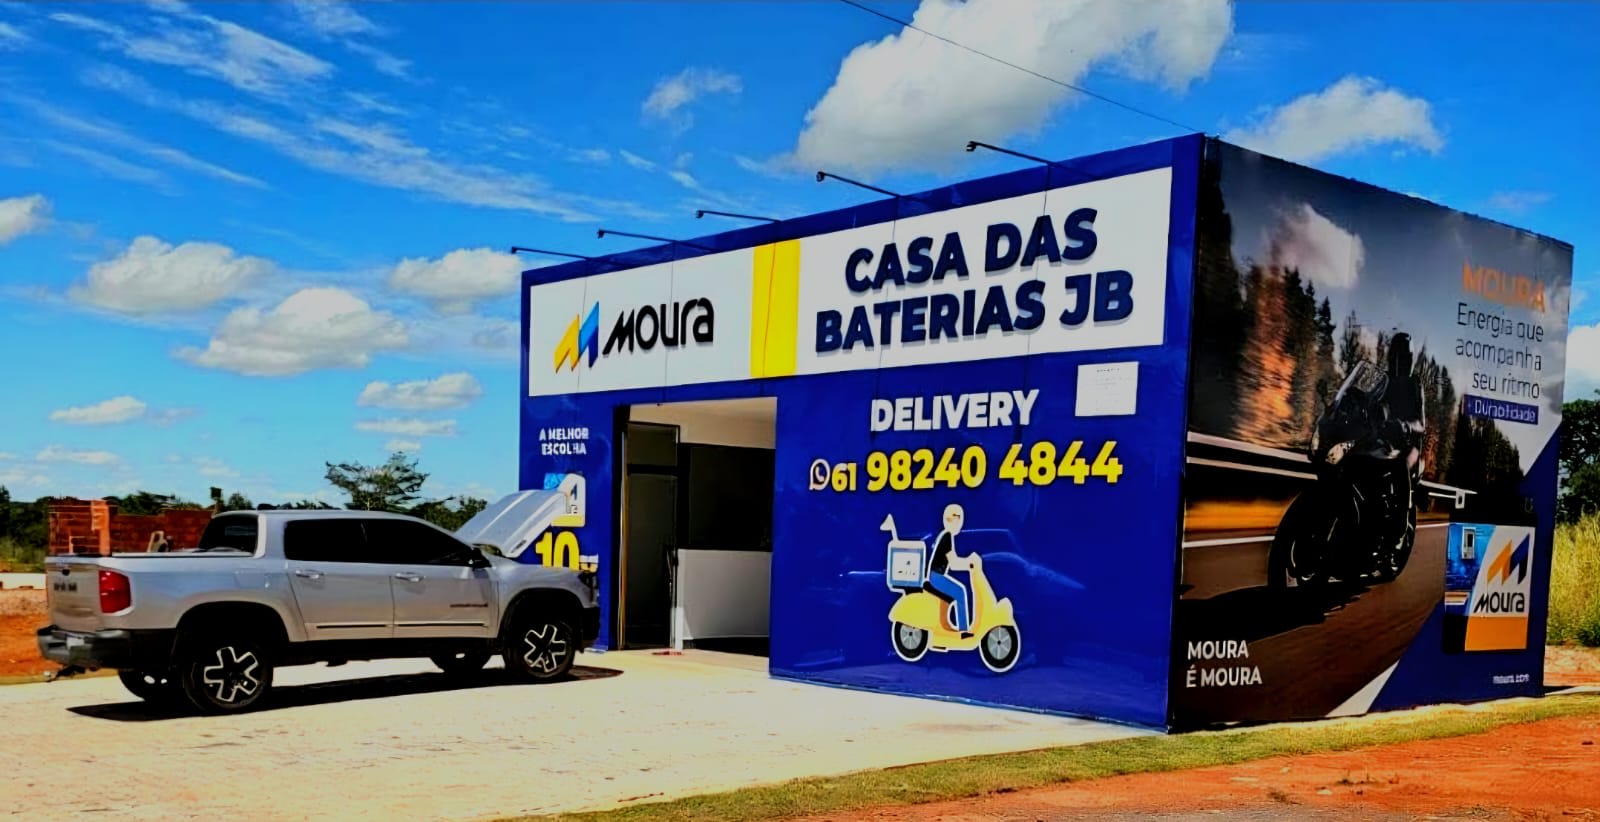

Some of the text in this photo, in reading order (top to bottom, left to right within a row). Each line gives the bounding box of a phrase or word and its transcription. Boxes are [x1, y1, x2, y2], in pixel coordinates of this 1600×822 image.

[845, 208, 1097, 292] CASA DAS
[1462, 262, 1545, 312] MOURA
[816, 270, 1133, 352] BATERIAS JB
[1457, 302, 1544, 346] Energia que
[1455, 338, 1542, 371] acompanha
[1472, 372, 1540, 399] seu ritmo
[870, 389, 1039, 431] DELIVERY
[539, 427, 589, 441] A MELHOR
[541, 442, 587, 455] ESCOLHA
[831, 441, 1123, 491] 61 98240 4844
[1187, 640, 1249, 660] MOURA
[1186, 664, 1263, 688] É MOURA
